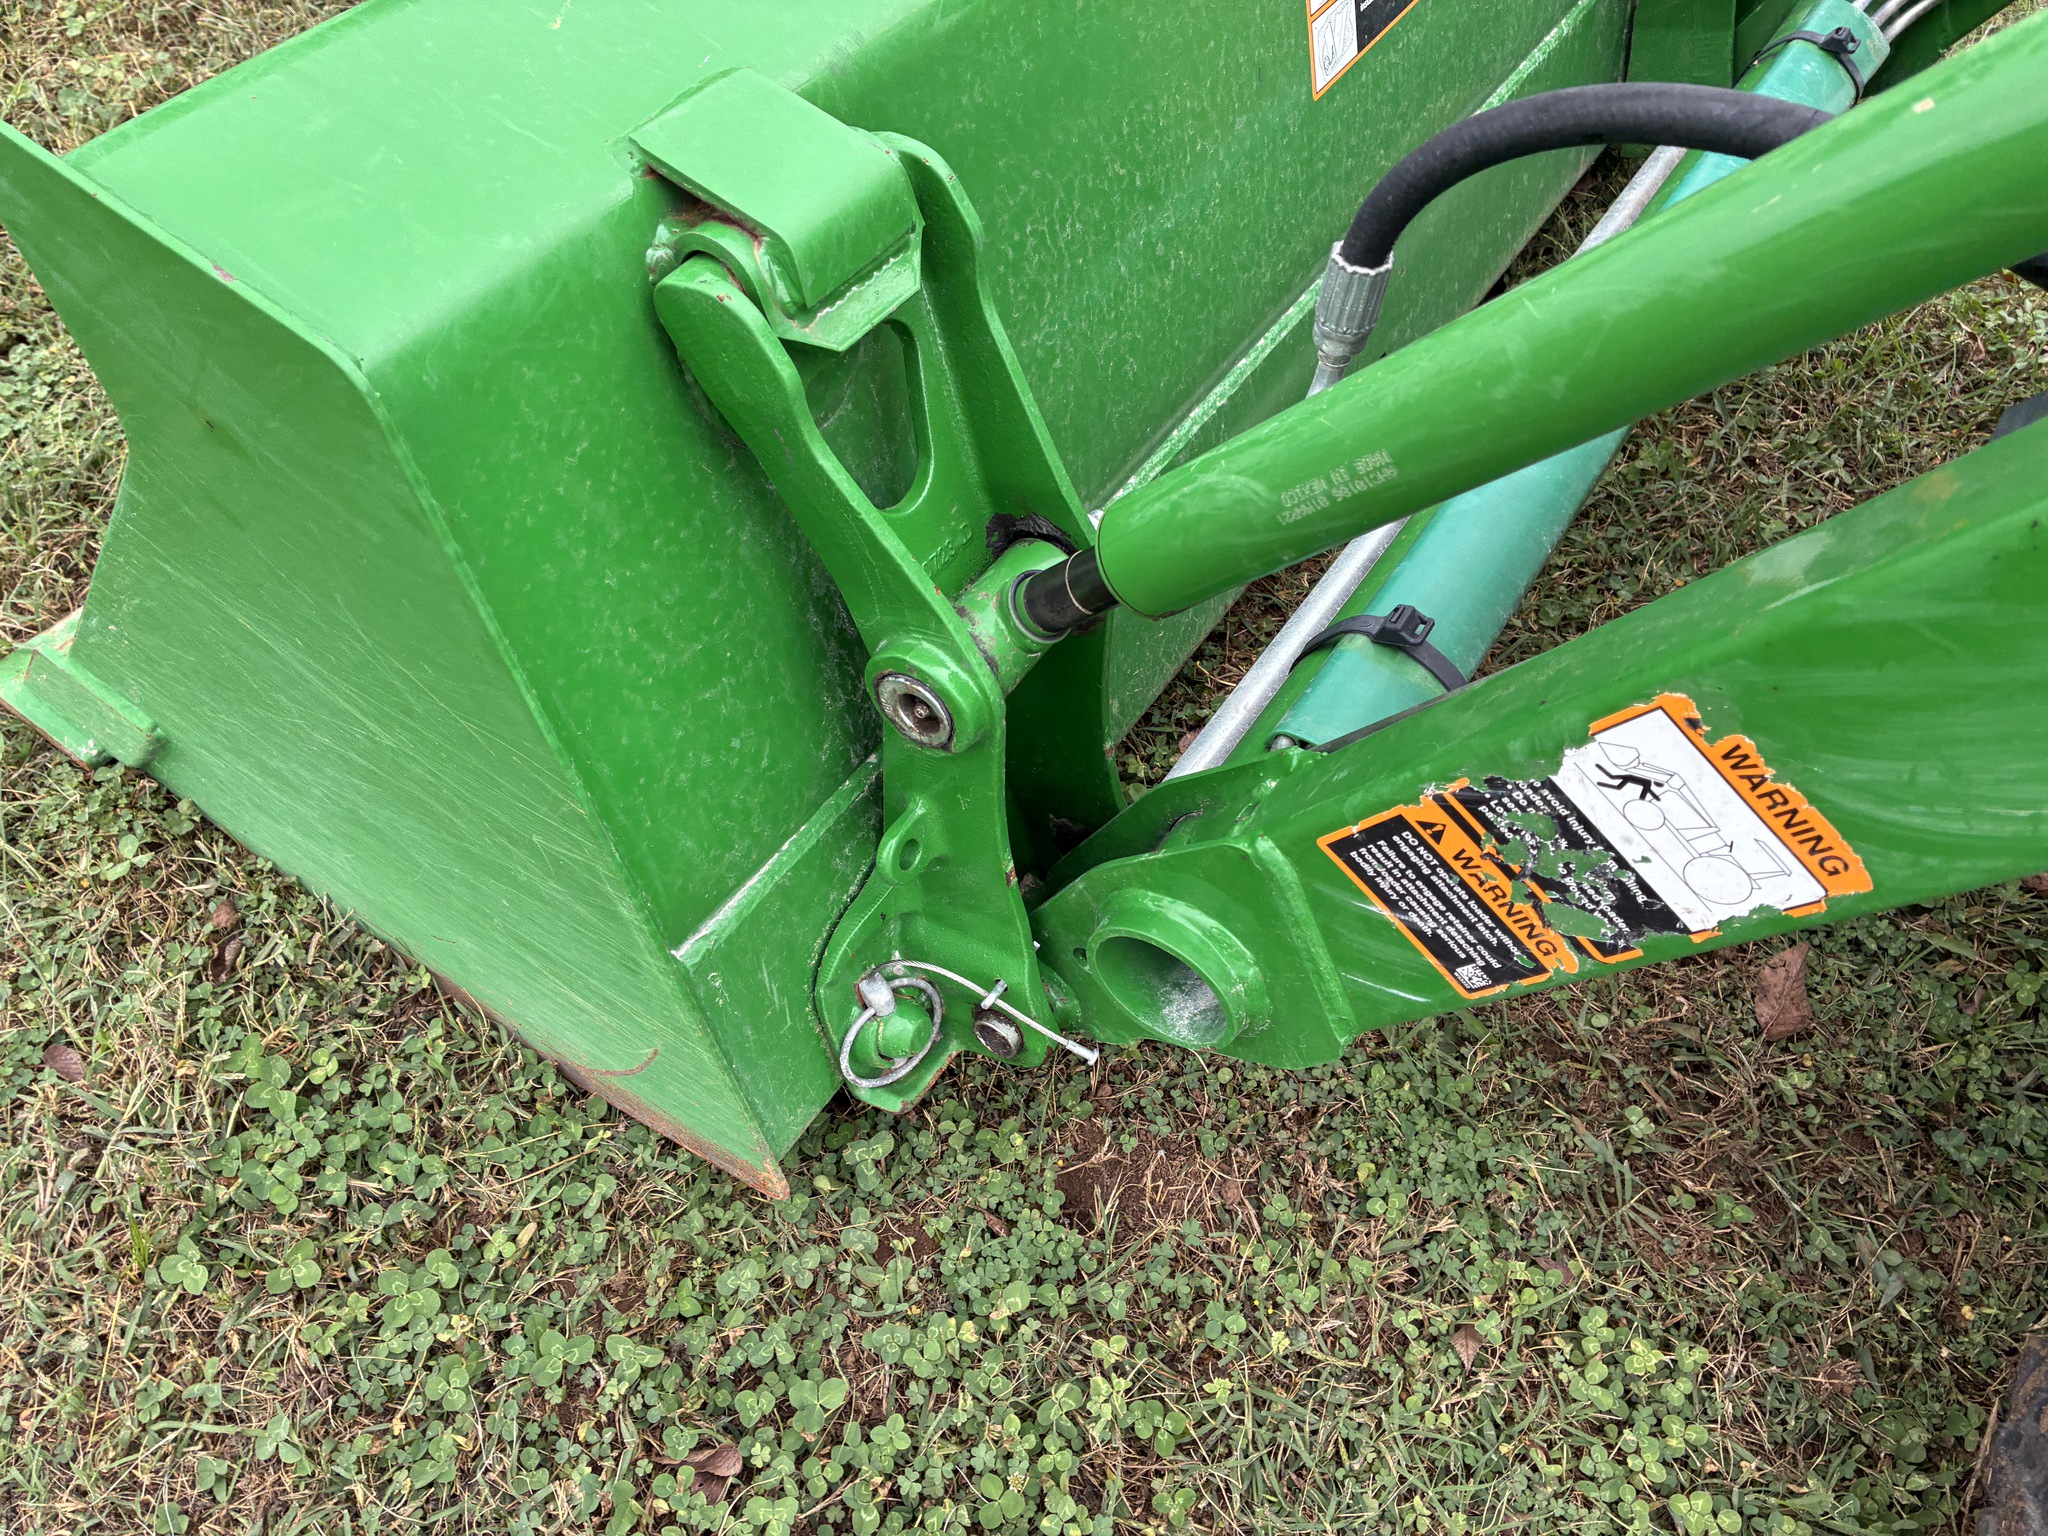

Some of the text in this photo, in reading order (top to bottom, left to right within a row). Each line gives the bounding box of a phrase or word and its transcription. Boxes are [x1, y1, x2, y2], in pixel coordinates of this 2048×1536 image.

[1511, 790, 1527, 806] Do
[1538, 788, 1570, 815] avoid
[1566, 816, 1596, 844] injury
[1721, 744, 1848, 875] WARNING
[1349, 850, 1432, 937] bodily injury or death.
[1358, 847, 1379, 868] from
[1376, 866, 1406, 894] loader
[1404, 895, 1438, 928] causing
[1435, 927, 1466, 958] serious
[1367, 844, 1393, 868] result
[1391, 868, 1401, 877] in
[1400, 878, 1448, 925] attachment
[1444, 925, 1485, 966] detaching
[1376, 839, 1406, 869] Failure
[1405, 869, 1416, 879] to
[1414, 880, 1446, 911] engage
[1444, 911, 1478, 943] retainer
[1475, 944, 1502, 968] could
[1392, 835, 1497, 946] engaging attachment latch.
[1401, 830, 1418, 845] DO
[1415, 846, 1439, 865] NOT
[1467, 900, 1495, 927] loader
[1494, 928, 1521, 955] witho
[1599, 903, 1630, 934] oader.
